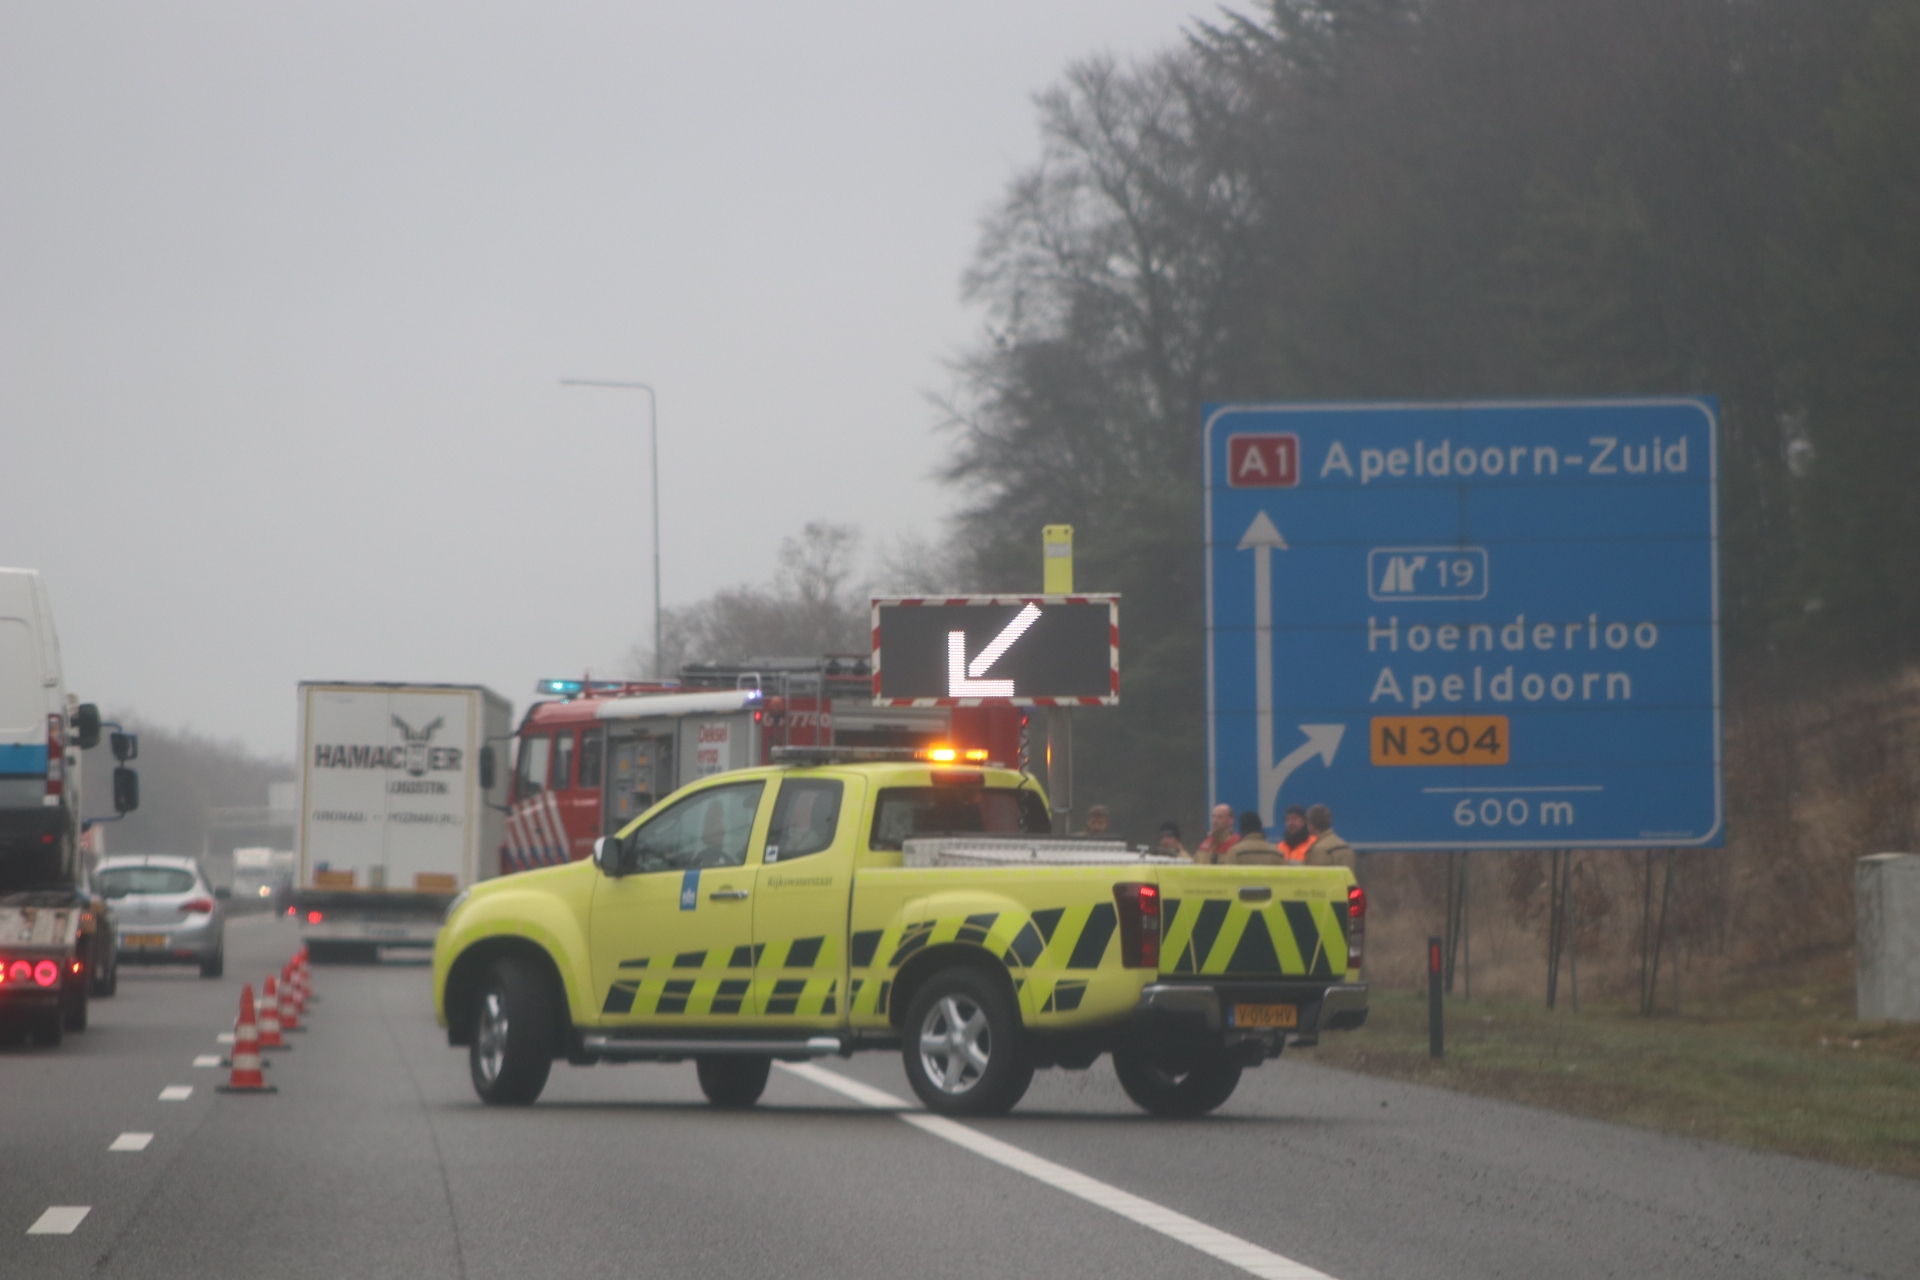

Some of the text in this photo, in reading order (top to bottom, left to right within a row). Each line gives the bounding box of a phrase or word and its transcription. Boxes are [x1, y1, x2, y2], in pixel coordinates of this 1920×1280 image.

[1239, 445, 1290, 477] A1
[1320, 436, 1688, 485] Apeldoorn-Zuid
[1437, 559, 1475, 587] 19
[1367, 613, 1658, 653] Hoenderloo
[1369, 665, 1632, 710] Apeldoorn
[1453, 799, 1574, 827] 600 m
